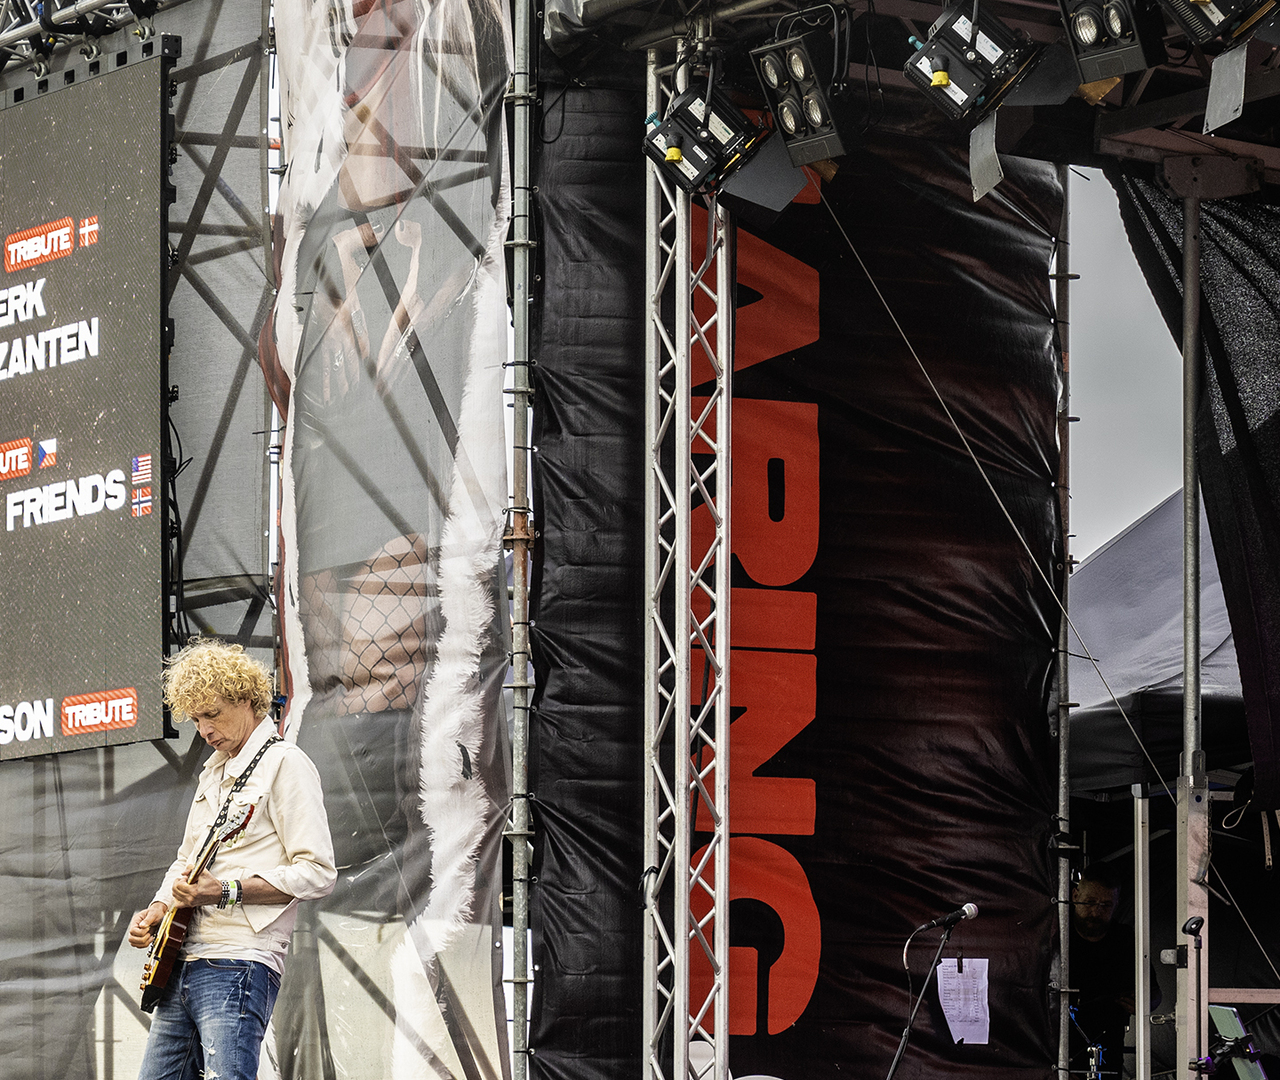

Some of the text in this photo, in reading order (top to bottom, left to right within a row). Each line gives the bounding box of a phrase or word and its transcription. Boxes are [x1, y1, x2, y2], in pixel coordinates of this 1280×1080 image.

[8, 227, 70, 264] TRIBUTE
[7, 469, 126, 531] FRIENDS
[65, 697, 133, 728] TRIBUTE
